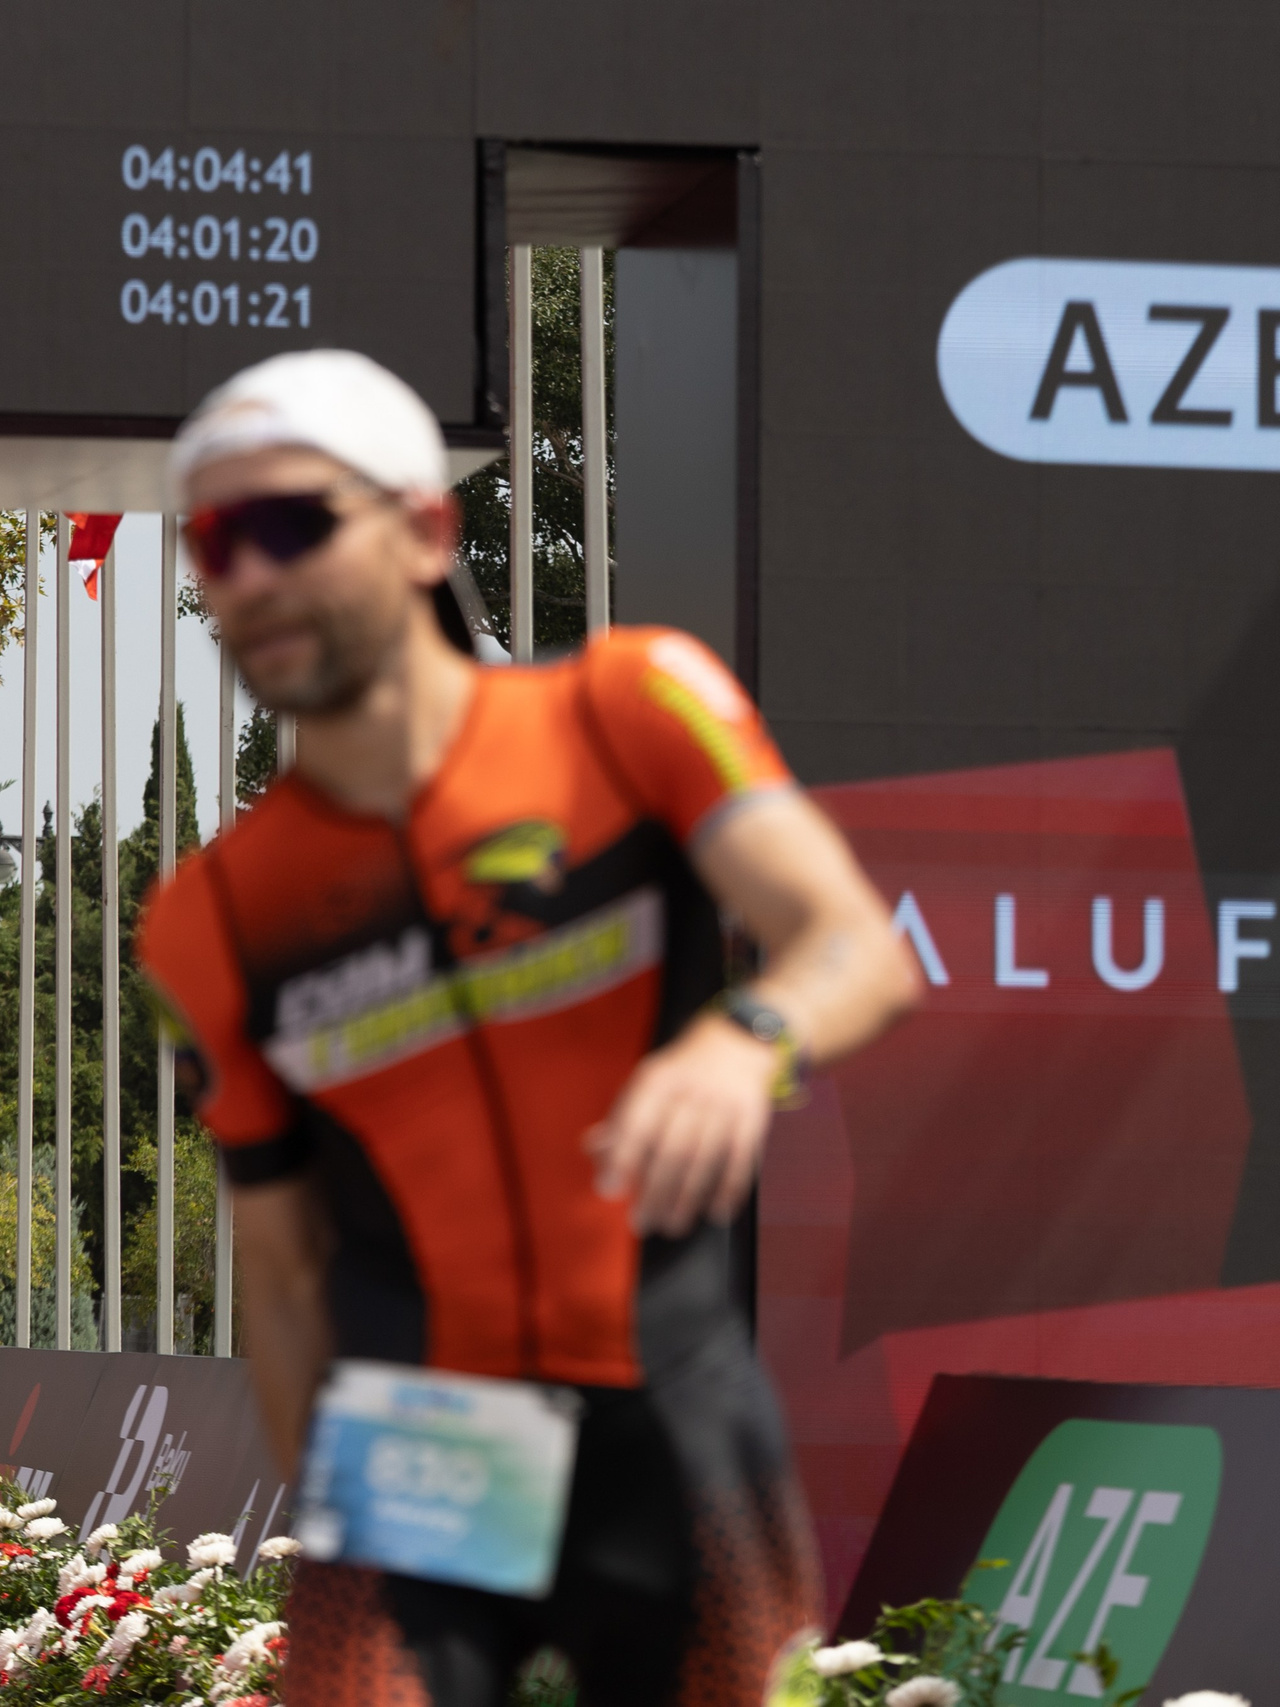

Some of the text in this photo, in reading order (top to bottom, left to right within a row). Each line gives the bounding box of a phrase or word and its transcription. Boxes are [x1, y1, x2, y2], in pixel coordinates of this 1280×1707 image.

[122, 144, 312, 195] 04:04:41
[121, 213, 319, 263] 04:01:20
[120, 279, 312, 328] 04:01:21
[970, 1483, 1183, 1698] AZE
